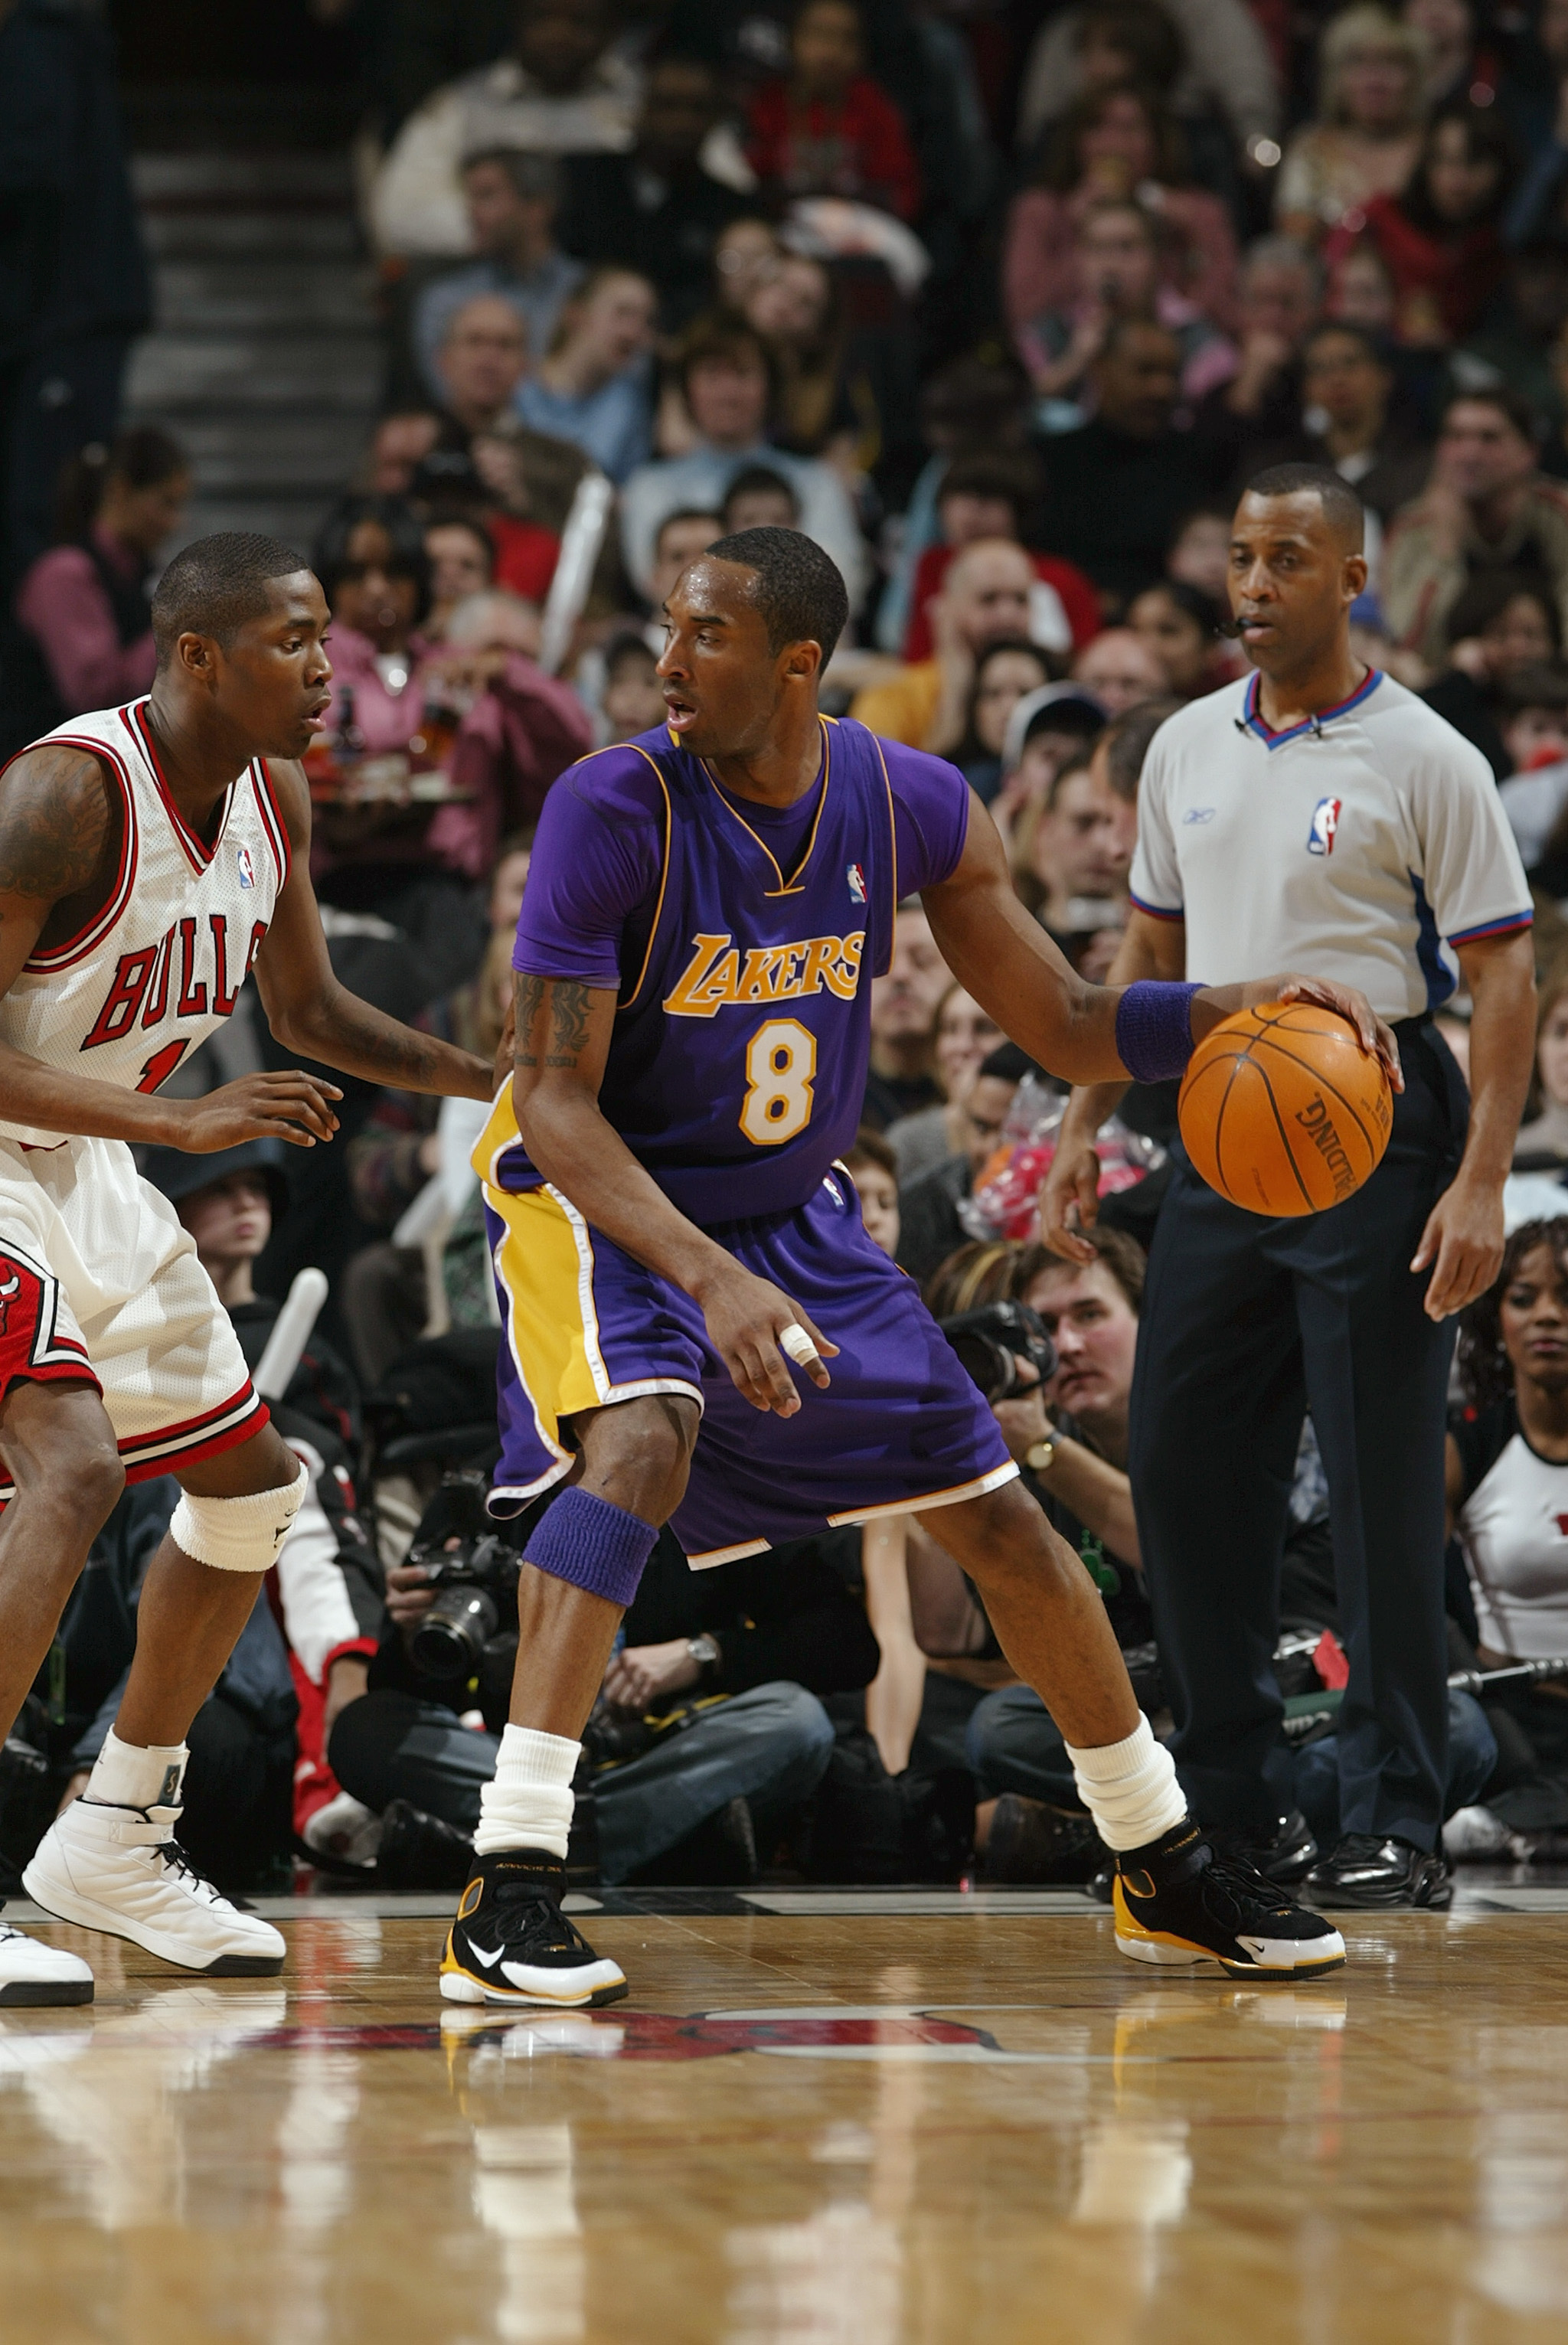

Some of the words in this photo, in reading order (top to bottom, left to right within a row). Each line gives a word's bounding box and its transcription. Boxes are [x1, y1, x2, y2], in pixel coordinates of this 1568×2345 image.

[662, 931, 867, 1018] LAKERS
[739, 1017, 818, 1146] 8
[1295, 1098, 1358, 1202] PALDING
